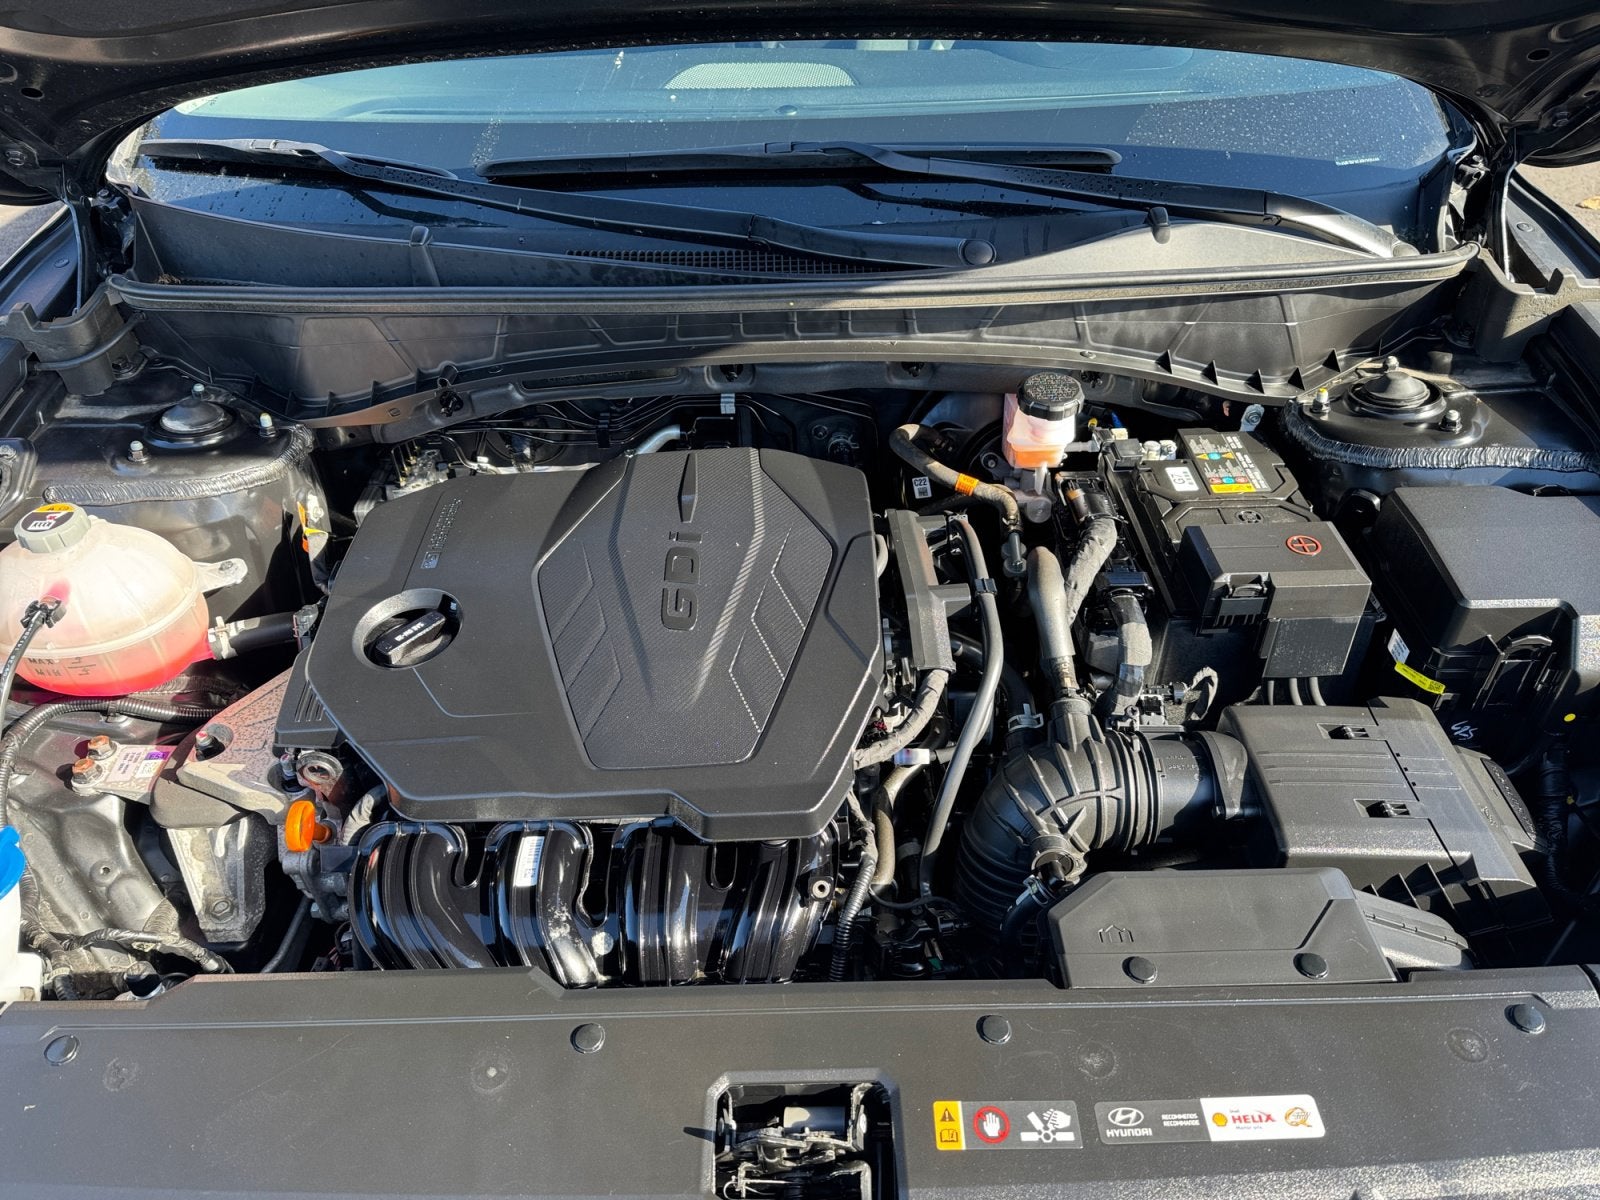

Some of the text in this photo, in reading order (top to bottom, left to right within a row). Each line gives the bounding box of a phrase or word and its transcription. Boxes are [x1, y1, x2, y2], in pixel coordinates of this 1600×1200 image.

[913, 477, 928, 487] C22
[27, 657, 54, 665] MAX
[34, 668, 62, 677] MIN
[1232, 1112, 1276, 1124] HELIX
[1106, 1127, 1153, 1138] HYUNDAI
